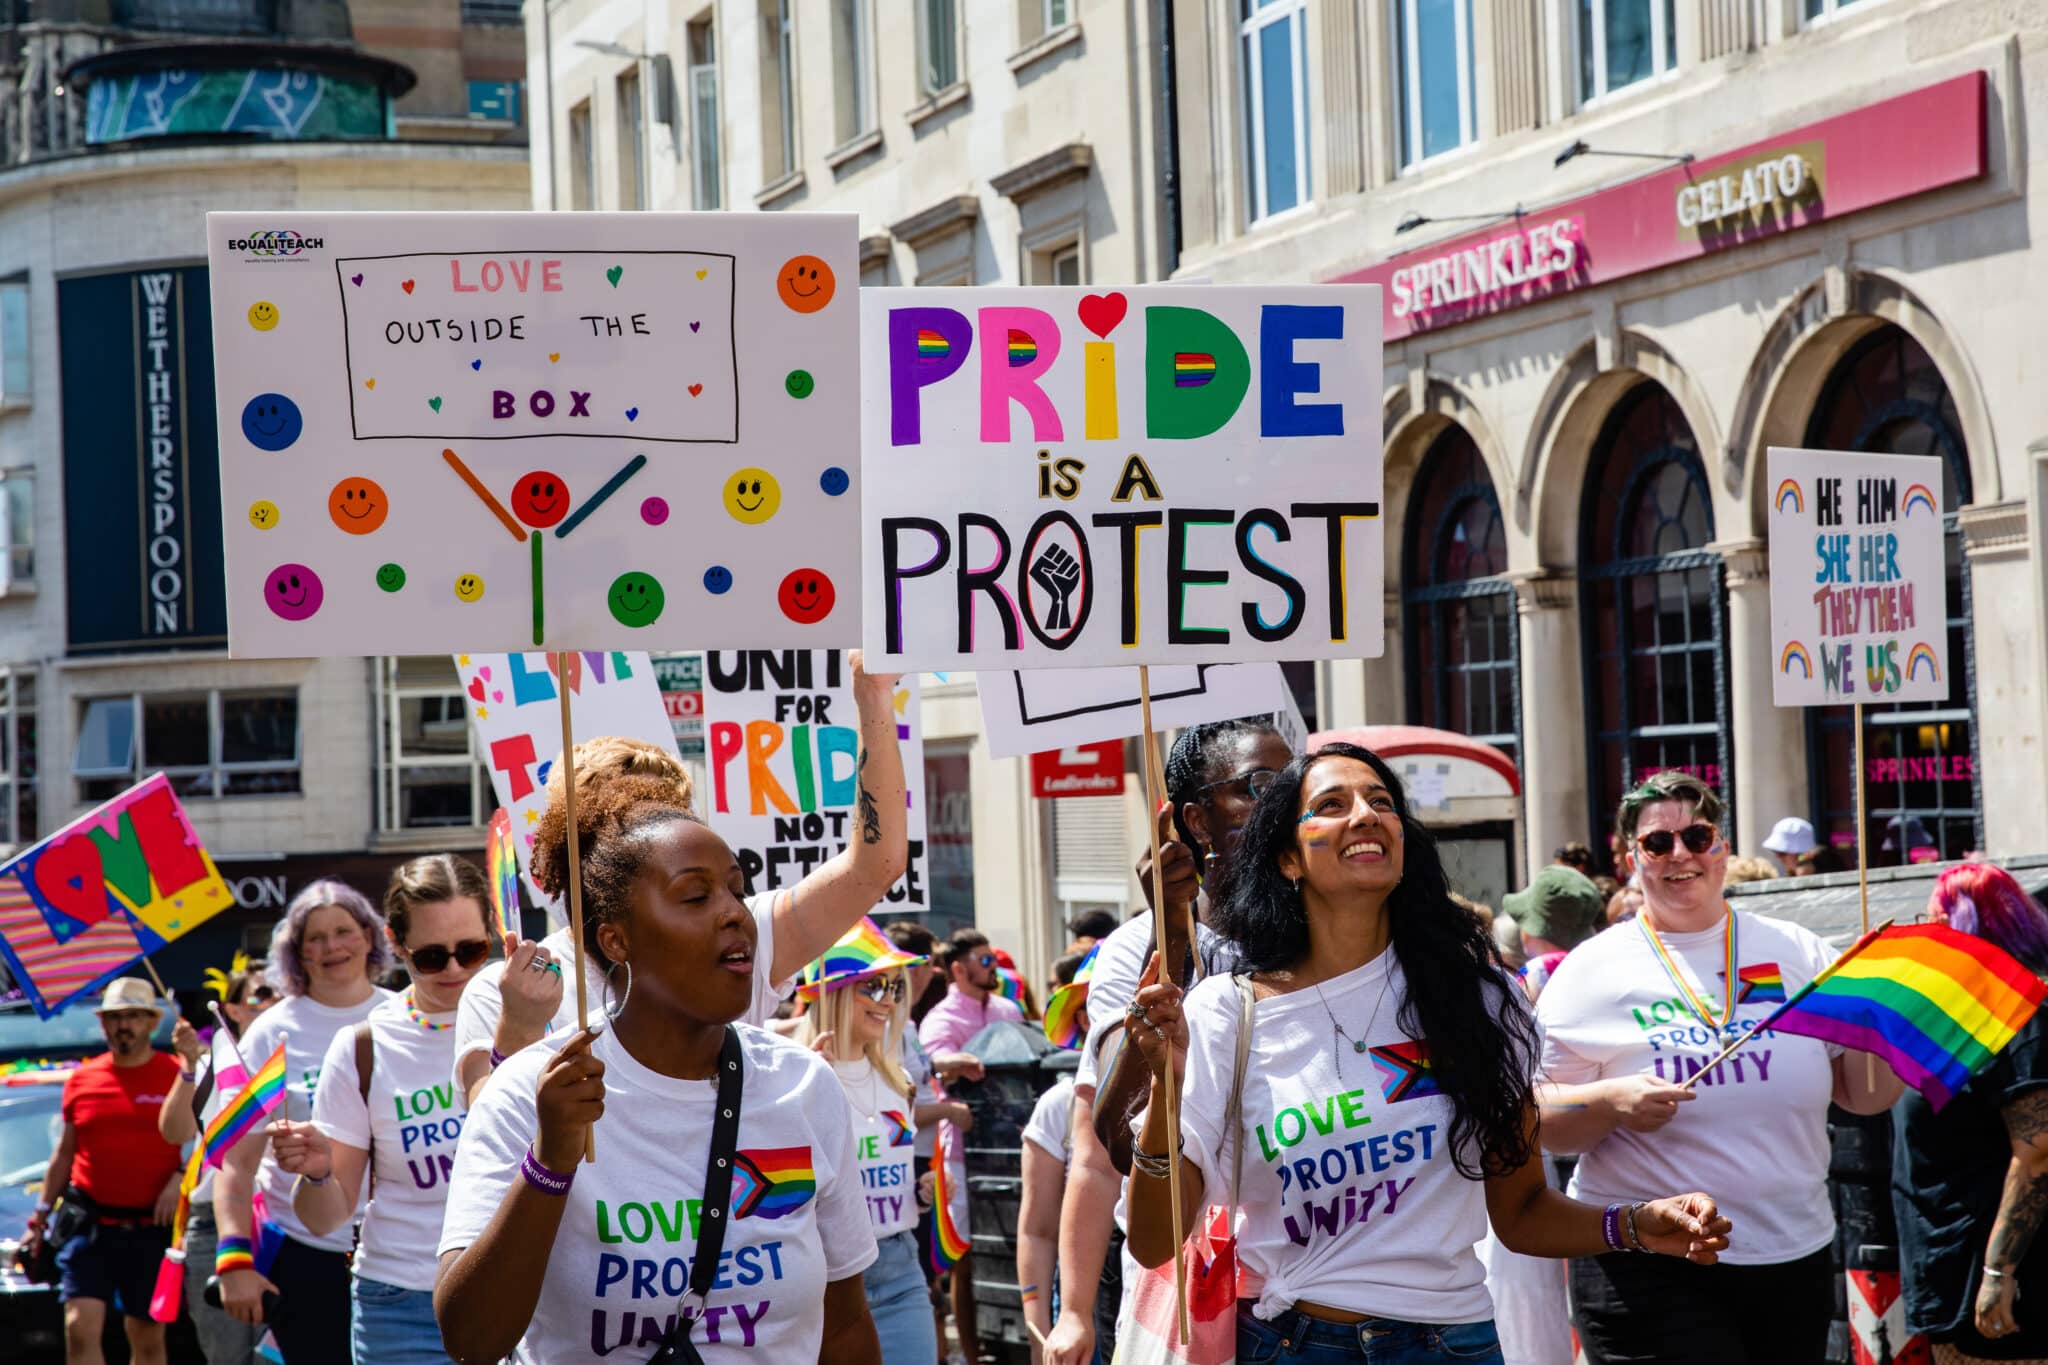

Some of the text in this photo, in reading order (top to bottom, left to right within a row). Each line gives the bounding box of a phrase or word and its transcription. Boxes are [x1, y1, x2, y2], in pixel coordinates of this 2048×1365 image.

[1677, 153, 1804, 227] GELATO
[228, 238, 324, 251] EQUALITEACH
[1392, 219, 1575, 318] SPRINKLES
[451, 259, 563, 292] LOVE
[385, 313, 651, 344] OUTSIDE THE
[492, 390, 592, 419] BOX
[140, 273, 182, 634] WETHERSPOON
[1111, 453, 1164, 502] A
[1816, 477, 1897, 527] HE HIM
[882, 502, 1379, 655] PROTEST
[1815, 532, 1902, 584] SHE HER
[1819, 640, 1902, 694] WE US
[775, 695, 832, 725] FOR
[710, 719, 912, 816] PRID
[774, 811, 848, 843] NOT
[400, 1112, 467, 1154] PRO
[1256, 1088, 1372, 1164] LOVE
[1276, 1123, 1437, 1206] PROTEST
[595, 1241, 784, 1300] PROEST
